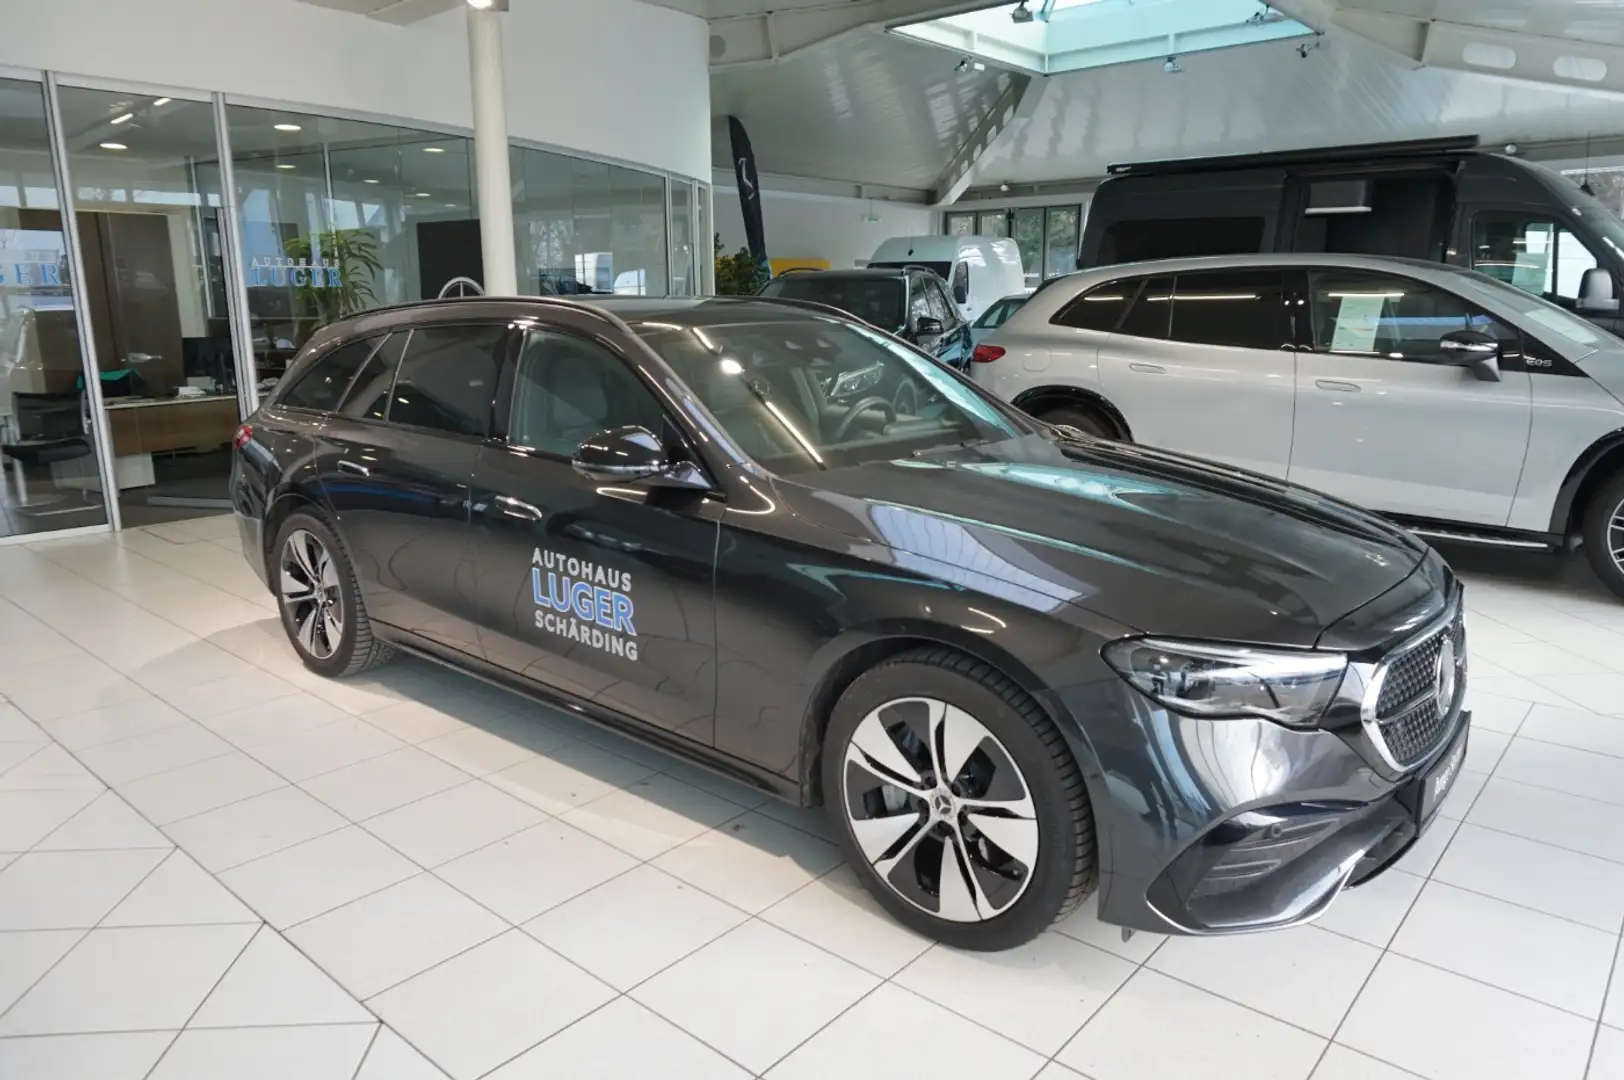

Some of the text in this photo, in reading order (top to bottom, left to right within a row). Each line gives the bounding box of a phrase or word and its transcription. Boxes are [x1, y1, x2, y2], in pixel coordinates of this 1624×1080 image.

[250, 266, 343, 287] LUGER
[251, 256, 341, 267] AUTOHAUS
[532, 547, 632, 592] AUTOHAUS
[532, 567, 637, 636] LUGER
[534, 610, 638, 661] SCHÄRDING
